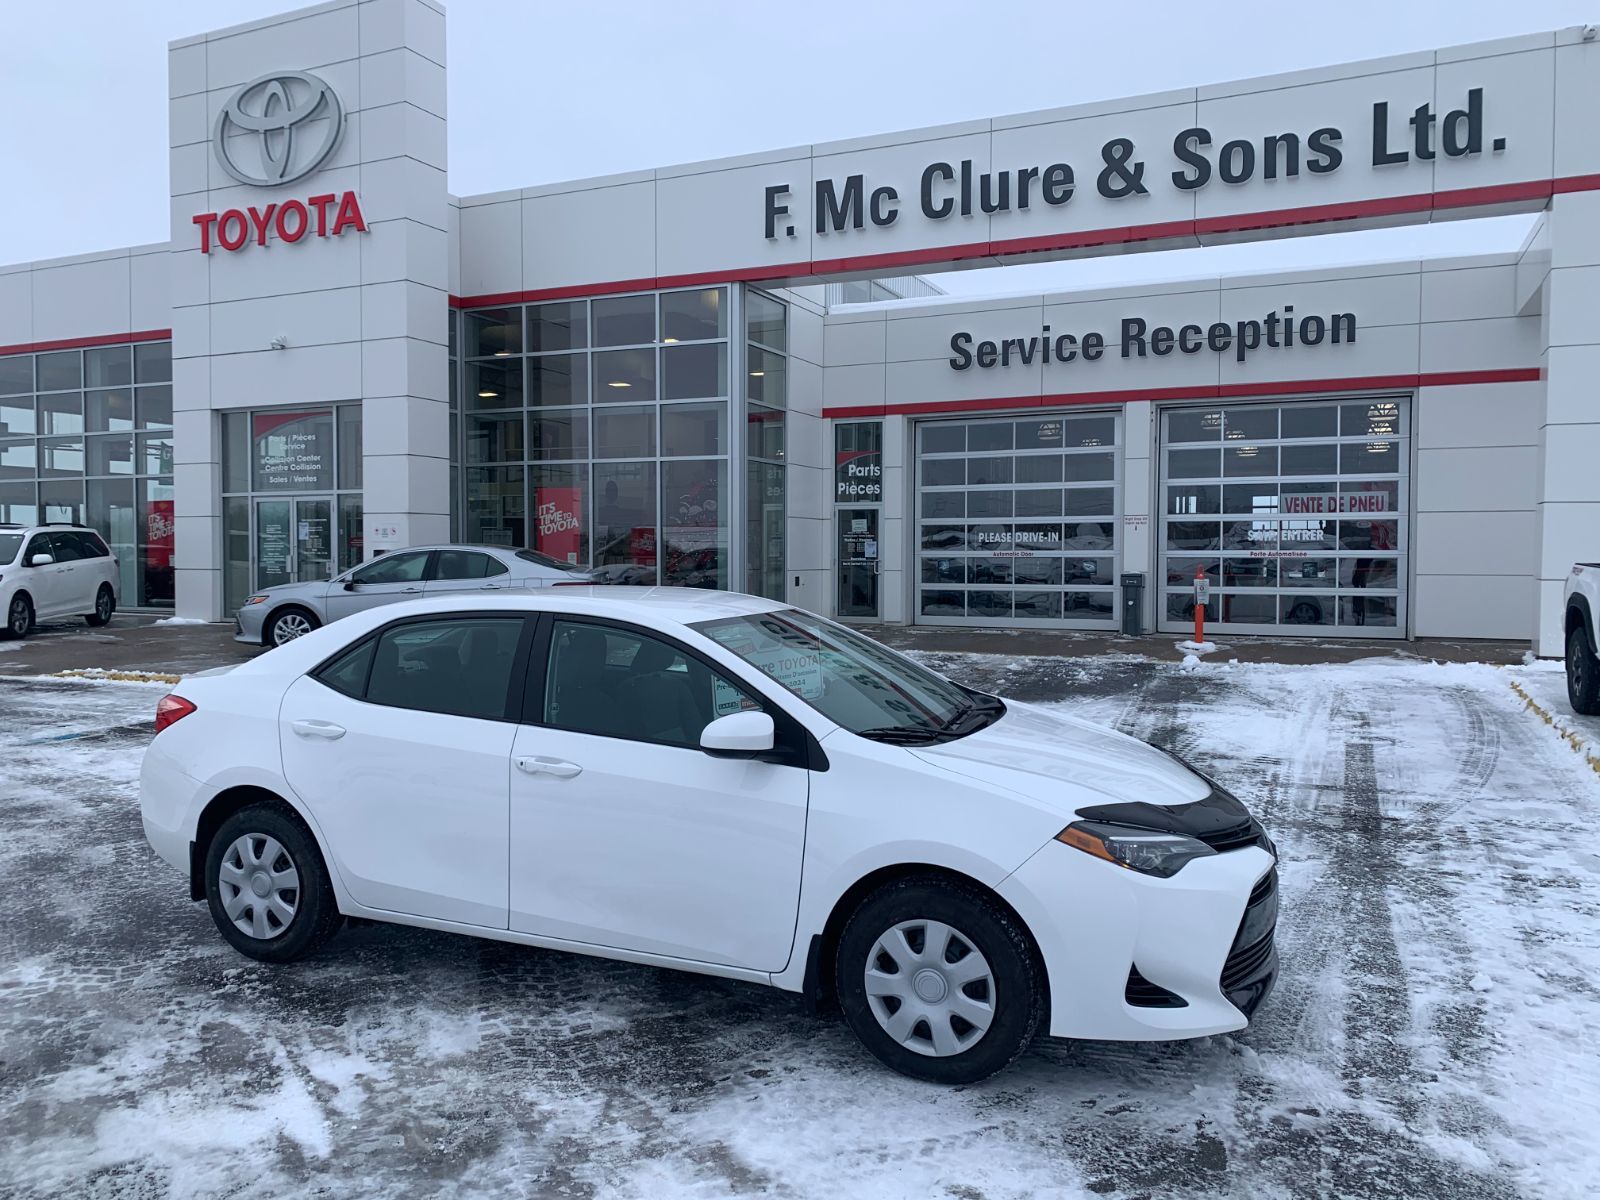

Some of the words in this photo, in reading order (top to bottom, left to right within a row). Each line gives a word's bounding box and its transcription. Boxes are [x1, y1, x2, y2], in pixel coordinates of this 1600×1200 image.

[765, 184, 796, 239] F.
[815, 174, 900, 235] Mc
[920, 159, 1076, 220] Clure
[1096, 137, 1150, 199] &
[1171, 127, 1344, 191] Sons
[1372, 87, 1508, 168] Ltd.
[192, 190, 367, 254] TOYOTA
[949, 325, 1104, 371] Service
[1120, 305, 1358, 362] Reception
[296, 454, 321, 463] Center
[264, 464, 289, 472] Centre
[290, 463, 322, 471] Collision
[848, 464, 881, 477] Parts
[269, 475, 289, 483] Sales
[293, 474, 318, 483] Ventes
[837, 481, 881, 495] Pièces
[538, 502, 556, 516] IT'S
[1284, 496, 1324, 513] VENTE
[1327, 496, 1345, 513] DE
[1349, 495, 1385, 512] PNEU
[539, 510, 563, 526] TIME
[539, 517, 580, 537] TOYOTA
[978, 532, 1012, 543] PLEASE
[1015, 531, 1059, 543] DRIVE-IN
[1281, 529, 1324, 541] ENTRER
[778, 655, 819, 672] TOYOTA
